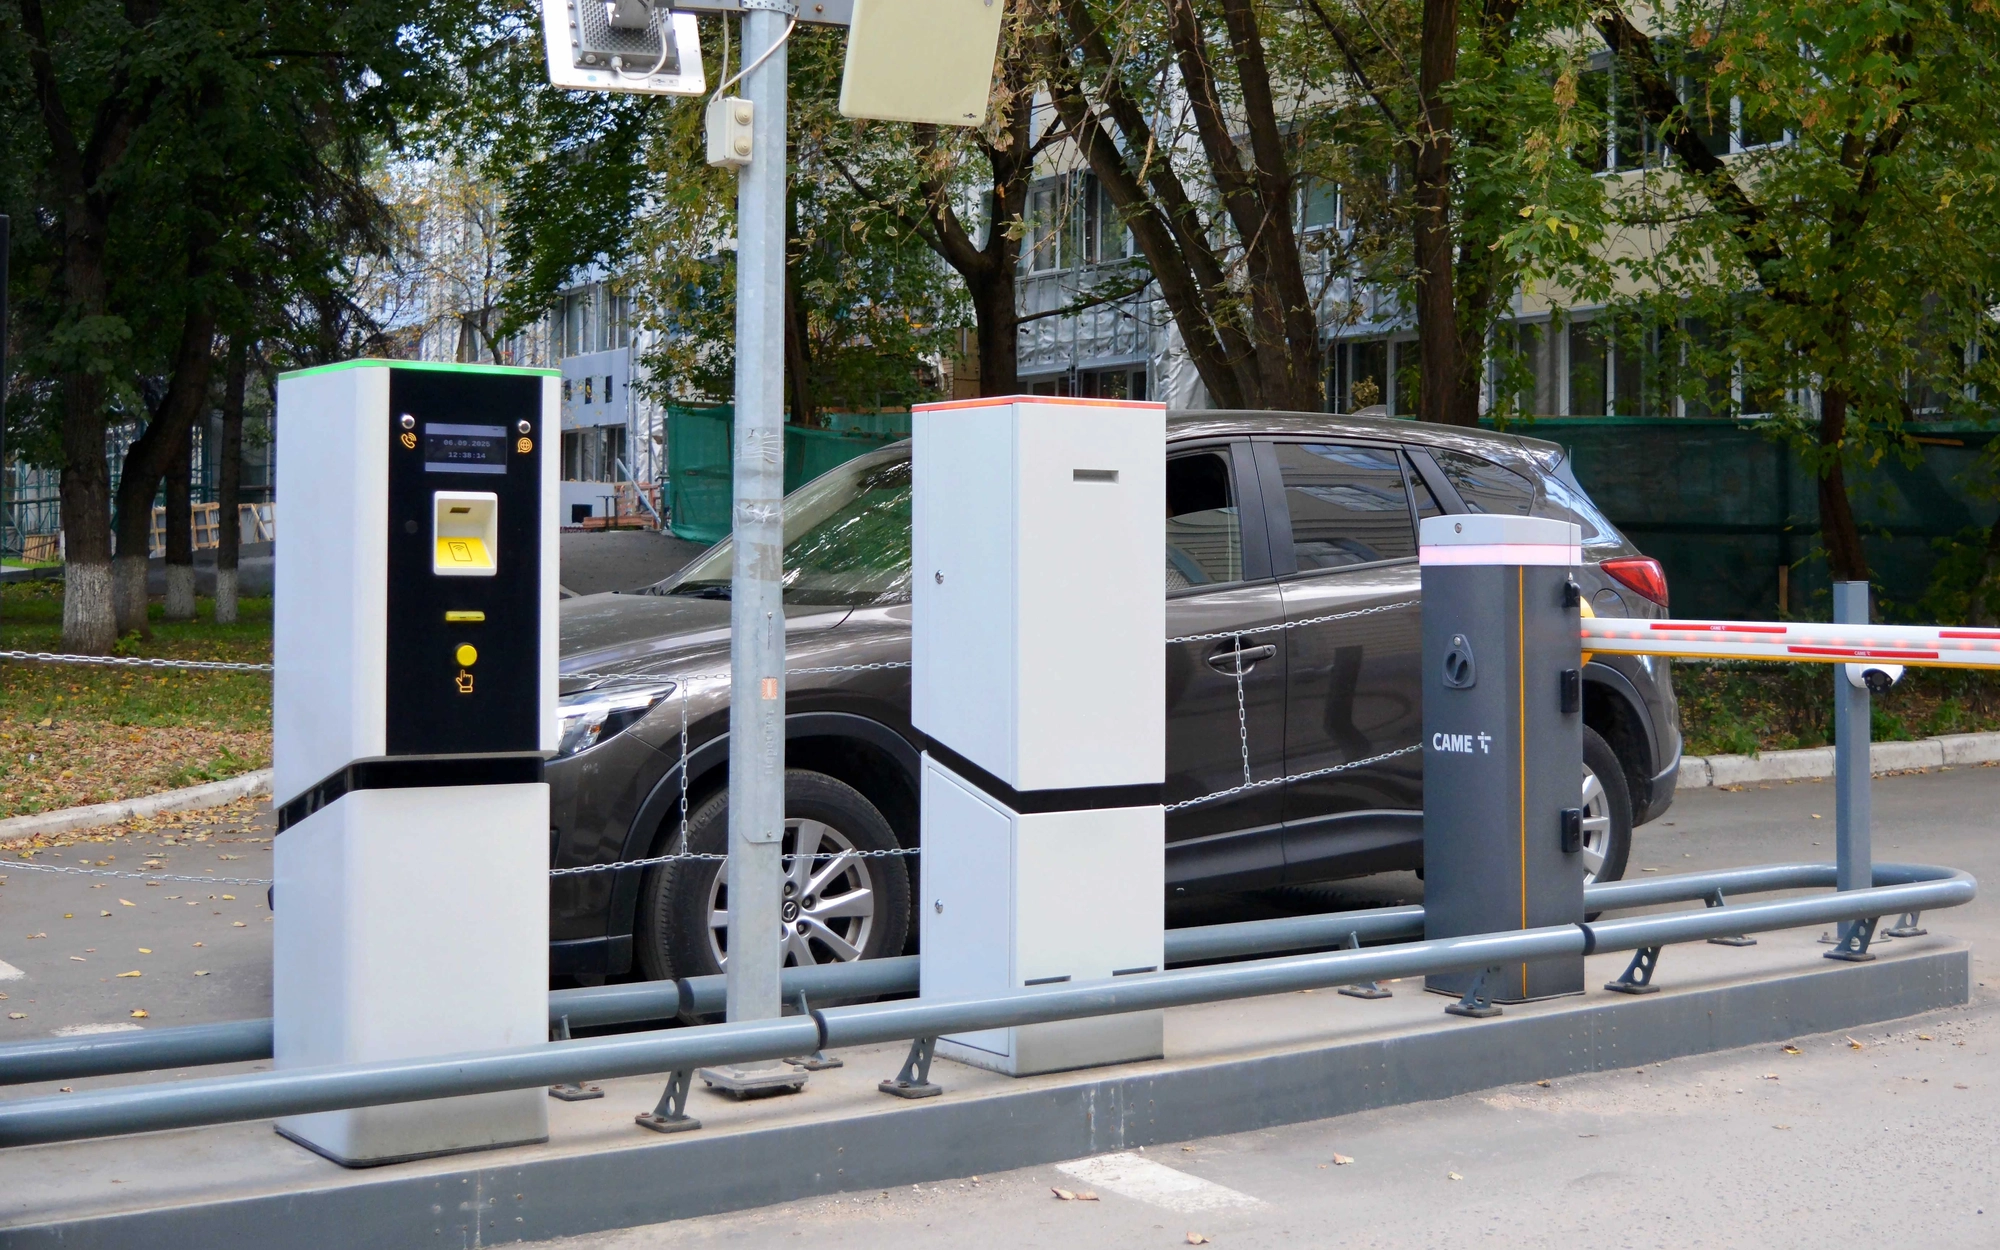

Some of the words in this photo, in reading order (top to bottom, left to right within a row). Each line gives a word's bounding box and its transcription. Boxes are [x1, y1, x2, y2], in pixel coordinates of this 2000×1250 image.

[443, 439, 491, 448] 06.09.2025
[448, 451, 486, 459] 12:38:14
[1432, 732, 1473, 753] CAME
